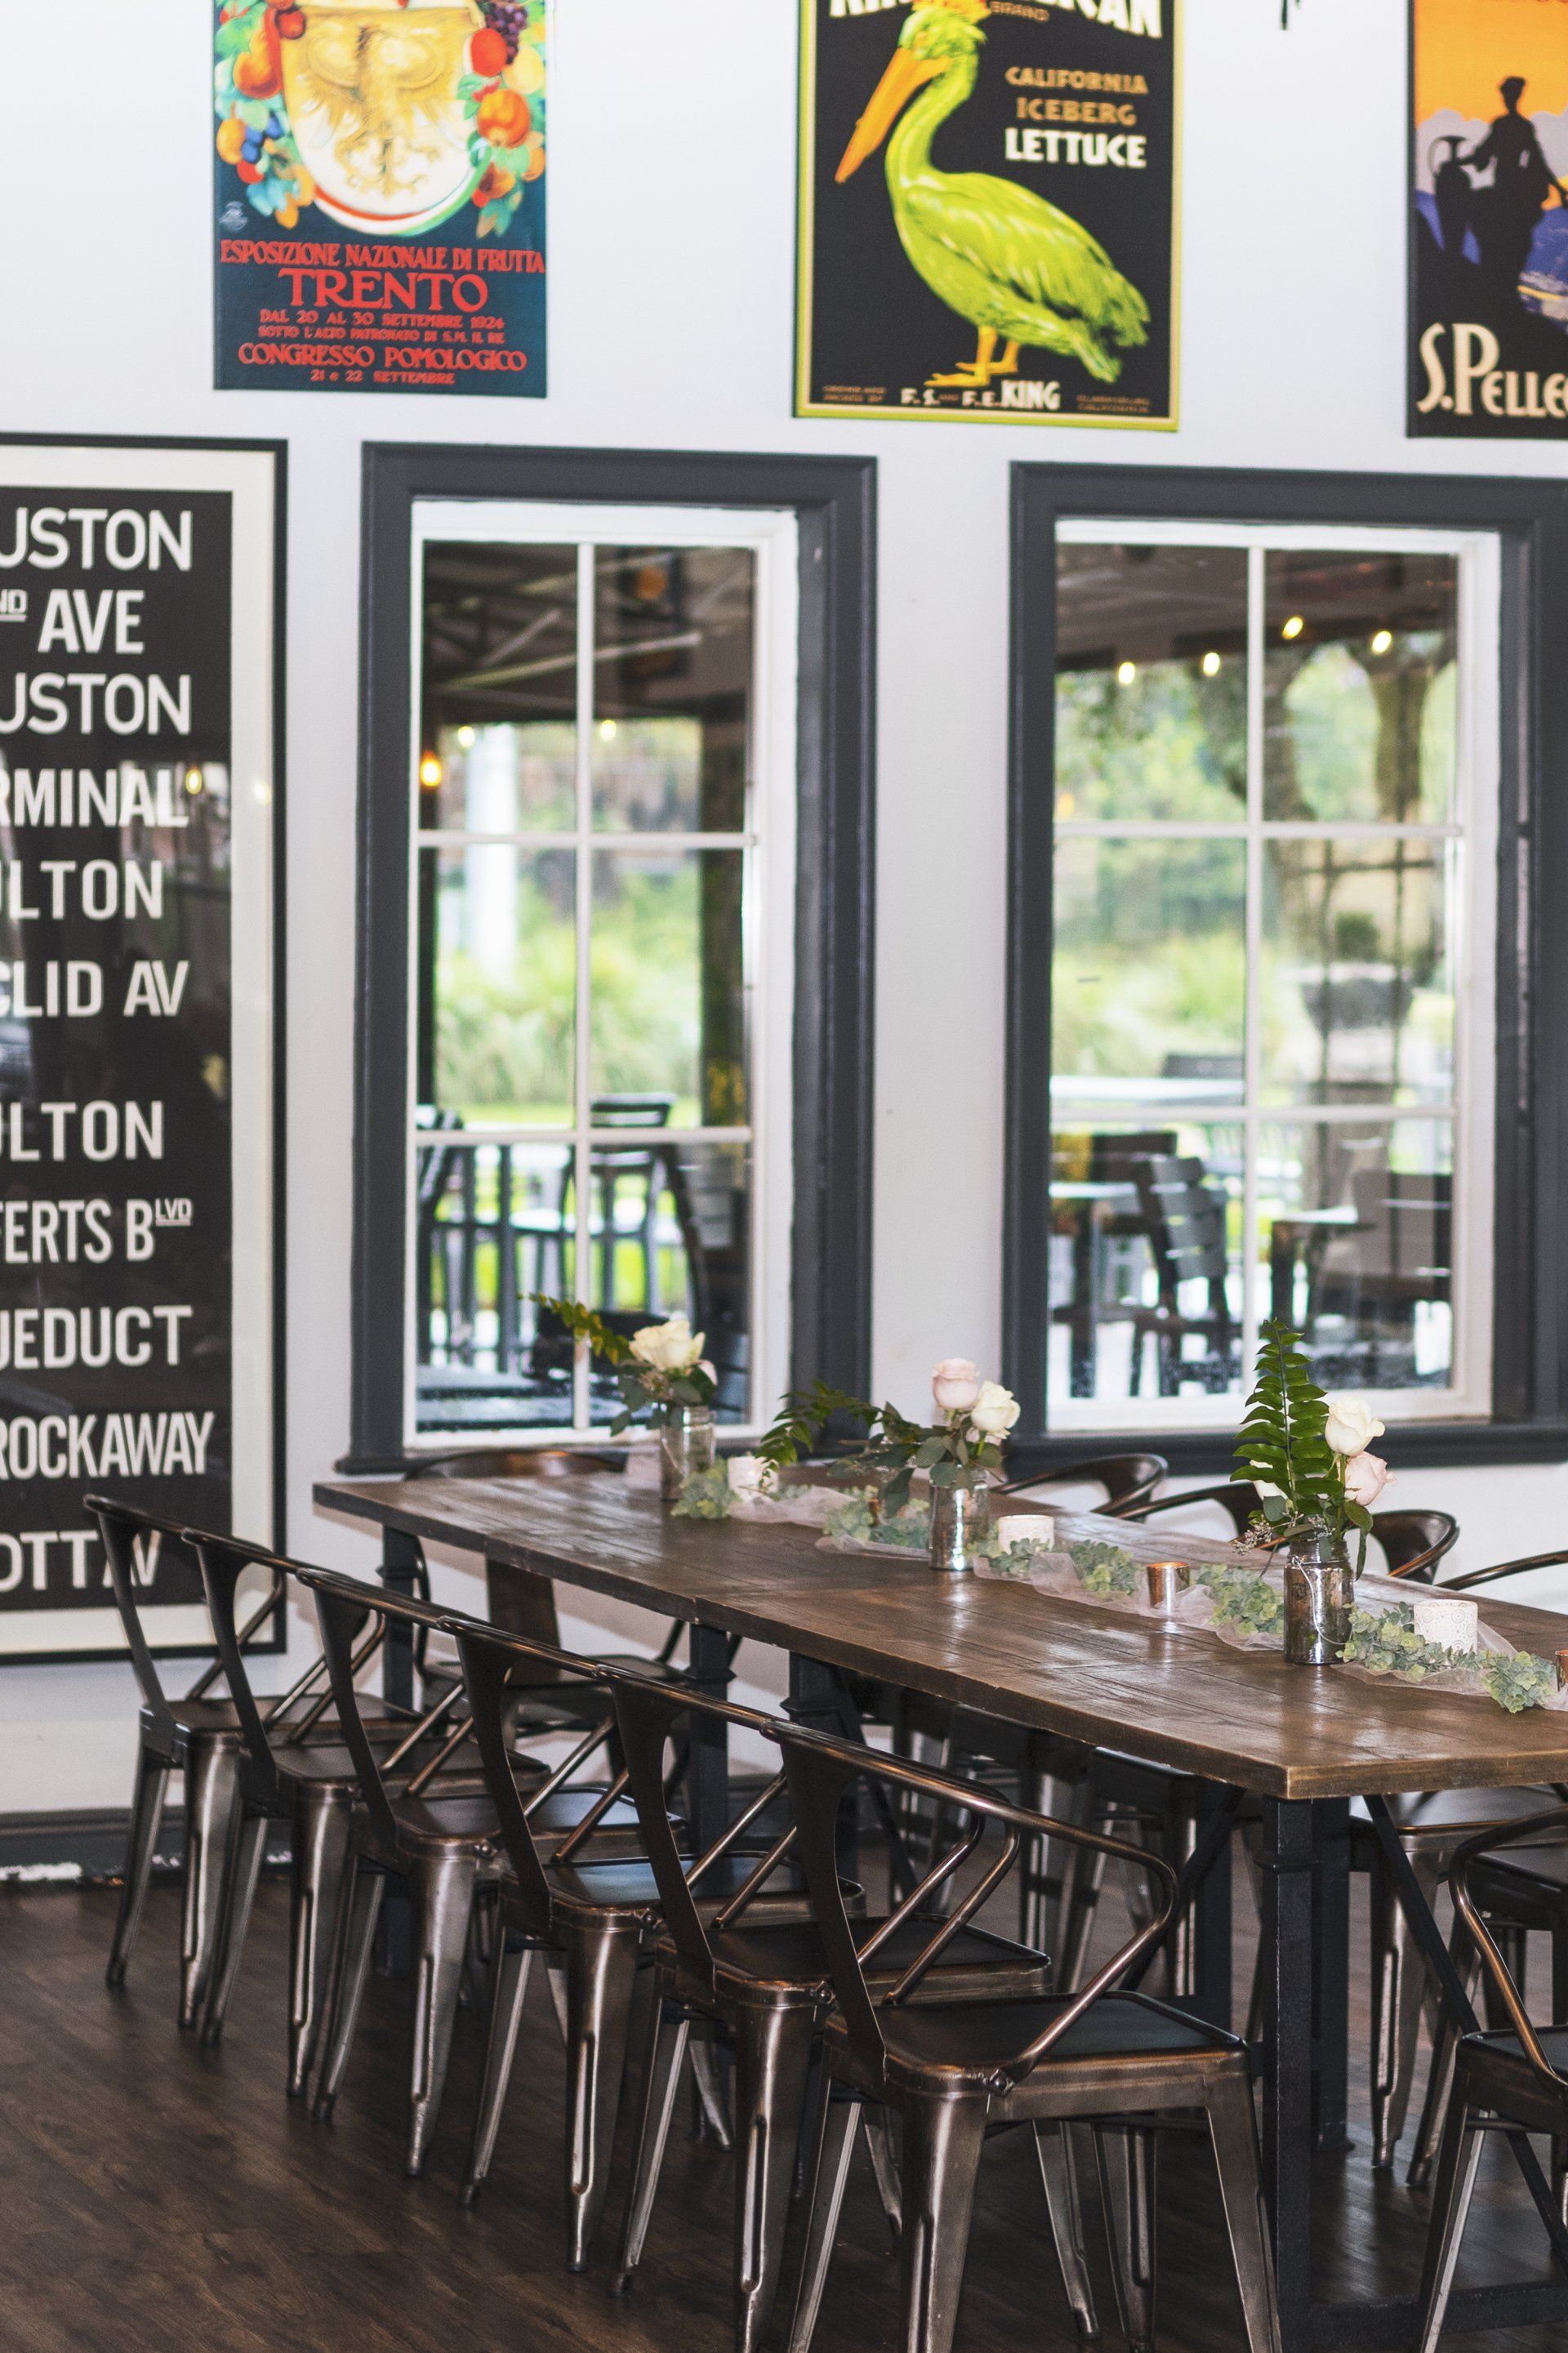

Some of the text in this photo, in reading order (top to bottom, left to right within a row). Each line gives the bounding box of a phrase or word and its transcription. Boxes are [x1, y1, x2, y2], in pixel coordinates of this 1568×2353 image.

[1005, 67, 1148, 94] CALIFORNIA
[1017, 97, 1136, 126] ICEBERG
[1005, 127, 1146, 168] LETTUCE
[221, 240, 545, 272] ESPOSIZIONE NAZIONALE DI FRUTTA
[278, 268, 488, 312] TRENTO
[261, 310, 289, 323] DAL
[298, 310, 318, 323] 20
[327, 312, 345, 324] AL
[354, 312, 374, 325] 30
[238, 344, 527, 370] CONGRESSO POMOLOGICO
[347, 371, 363, 381] 22
[1001, 380, 1060, 410] KING
[38, 589, 145, 653] AVE
[0, 860, 163, 919] LTON
[124, 961, 188, 1015] AV
[0, 1101, 162, 1161] LTON
[0, 1199, 112, 1263] ERTS
[0, 1412, 214, 1479] OCKAWAY
